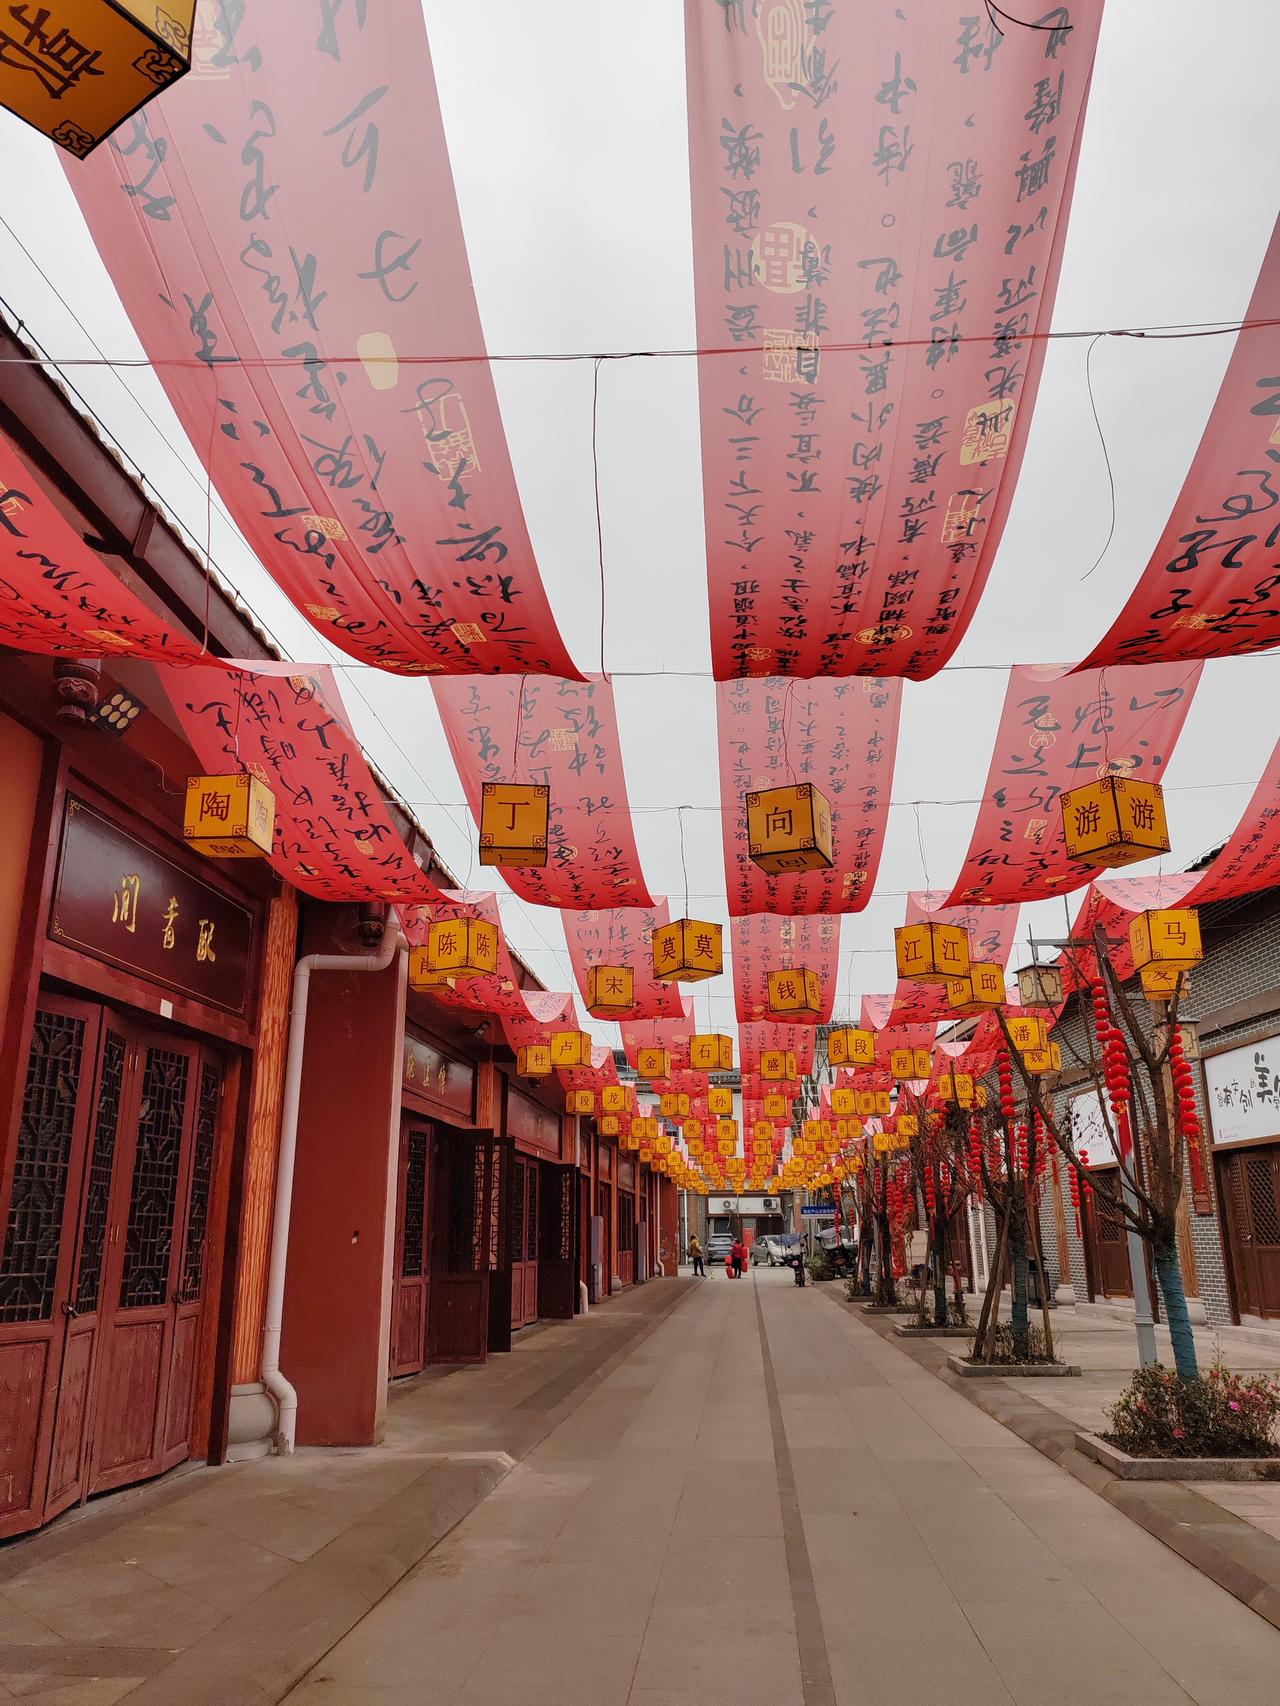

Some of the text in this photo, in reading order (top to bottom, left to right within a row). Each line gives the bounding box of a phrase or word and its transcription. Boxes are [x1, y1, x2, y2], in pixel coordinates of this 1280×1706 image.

[0, 5, 104, 99] 郭
[200, 791, 230, 821] 陶
[498, 802, 529, 830] 丁
[1129, 796, 1156, 833] 游
[766, 807, 792, 838] 向
[1074, 803, 1100, 838] 游
[1164, 922, 1186, 945] 马
[438, 932, 460, 958] 陈
[476, 933, 491, 958] 陈
[661, 937, 675, 962] 莫
[695, 934, 713, 959] 莫
[905, 940, 922, 962] 江
[942, 939, 960, 961] 江
[605, 976, 623, 994] 宋
[777, 981, 796, 1000] 钱
[981, 974, 996, 992] 邱
[1012, 1025, 1030, 1044] 潘
[559, 1040, 574, 1057] 卢
[697, 1043, 712, 1060] 石
[853, 1039, 867, 1057] 段
[1029, 1049, 1047, 1063] 魏
[533, 1052, 547, 1067] 杜
[644, 1055, 657, 1070] 金
[767, 1057, 780, 1072] 盛
[607, 1092, 620, 1105] 龙
[713, 1095, 727, 1108] 孙
